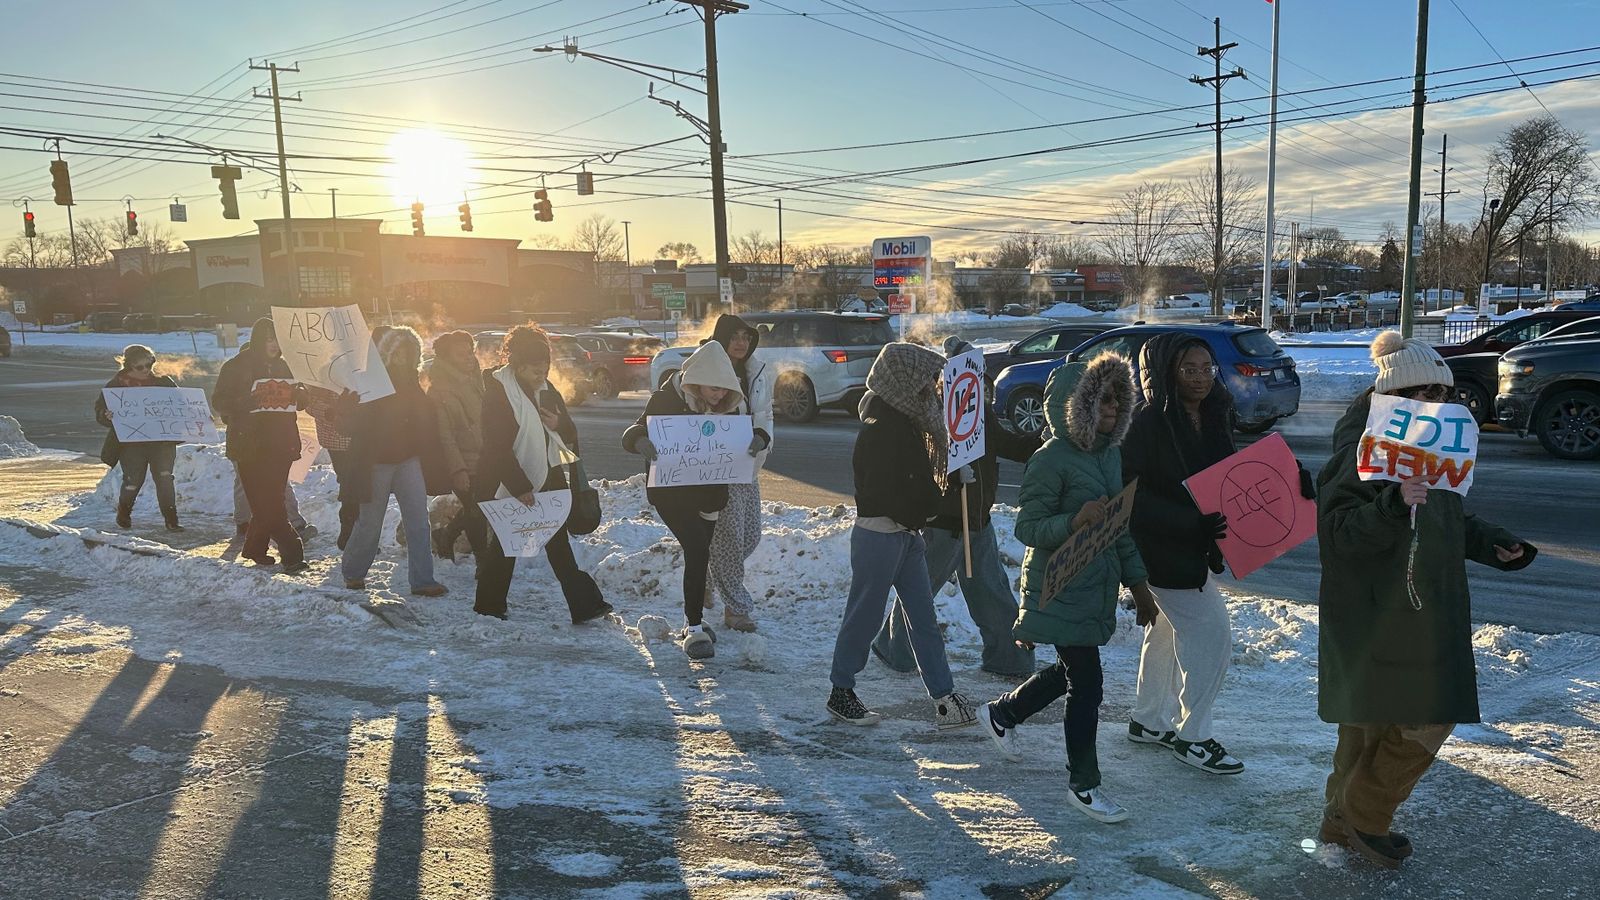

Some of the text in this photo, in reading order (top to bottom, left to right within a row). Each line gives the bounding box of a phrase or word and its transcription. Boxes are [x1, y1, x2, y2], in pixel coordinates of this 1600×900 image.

[882, 240, 916, 256] Mobil
[143, 406, 208, 419] ABOLISH
[655, 417, 673, 441] IF
[1384, 408, 1472, 453] ICE
[684, 442, 702, 454] act
[708, 440, 727, 453] like
[660, 465, 737, 485] WE WILL
[1227, 477, 1281, 522] ICE
